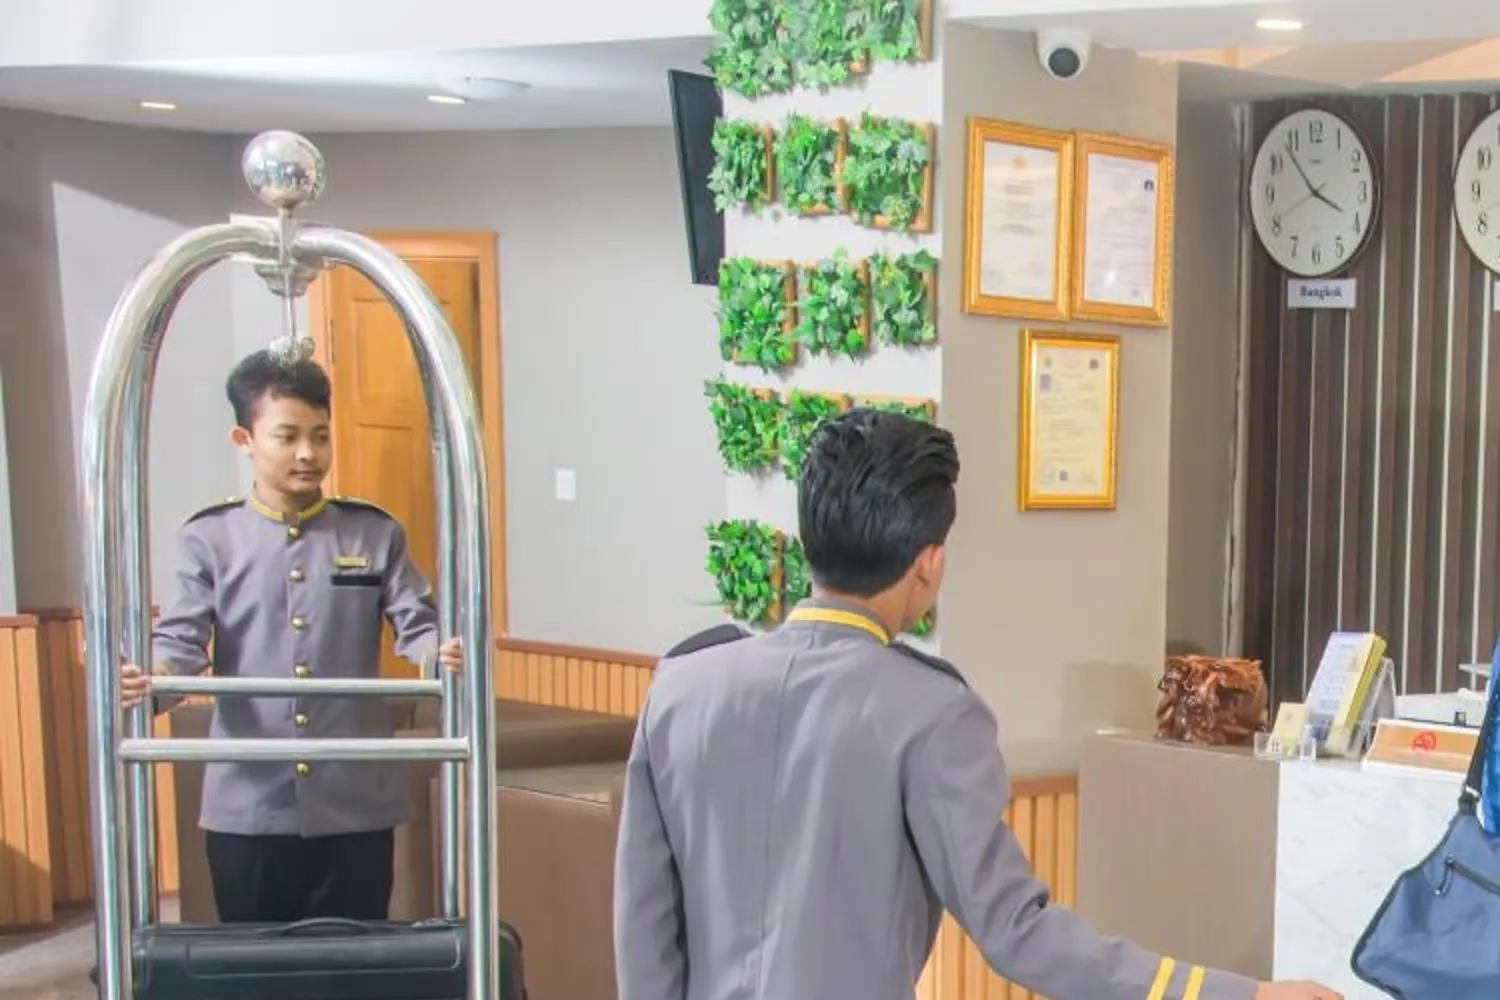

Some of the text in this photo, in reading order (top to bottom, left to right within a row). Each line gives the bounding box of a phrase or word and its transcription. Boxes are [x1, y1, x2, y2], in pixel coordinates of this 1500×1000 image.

[1287, 128, 1299, 151] 11
[1309, 119, 1324, 144] 12
[1336, 127, 1342, 151] 1
[1270, 152, 1283, 176] 10
[1351, 149, 1361, 173] 2
[1477, 146, 1492, 172] 10
[1265, 183, 1275, 205] 9
[1357, 181, 1367, 204] 3
[1471, 179, 1481, 202] 9
[1272, 214, 1282, 237] 8
[1351, 211, 1361, 235] 4
[1477, 211, 1488, 235] 8
[1290, 235, 1299, 258] 7
[1311, 243, 1322, 265] 6
[1335, 235, 1345, 258] 5
[1300, 284, 1342, 300] Bangkok
